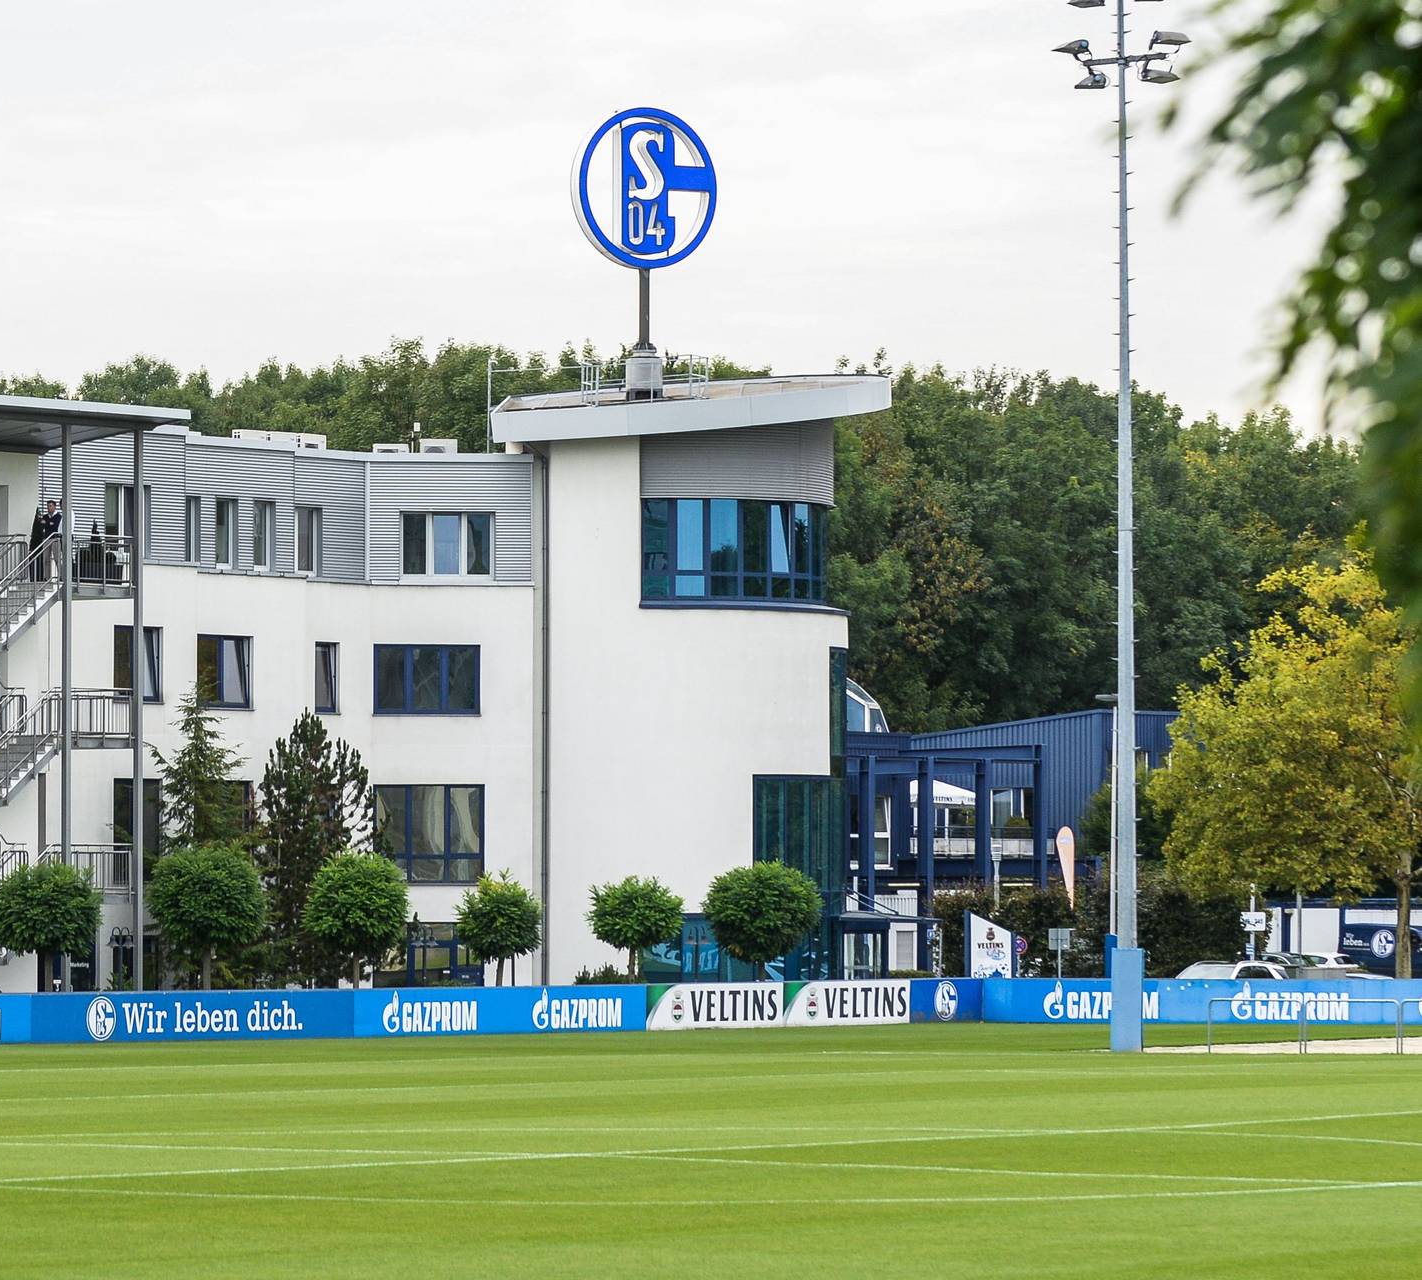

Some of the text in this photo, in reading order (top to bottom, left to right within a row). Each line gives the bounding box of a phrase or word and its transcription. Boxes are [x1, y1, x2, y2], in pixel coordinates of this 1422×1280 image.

[628, 201, 666, 246] 04
[977, 942, 1004, 950] VELTINS
[121, 1000, 303, 1034] Wir leben dich.
[402, 1000, 477, 1033] GAZPROM
[550, 998, 622, 1029] GAZPROM
[690, 989, 778, 1022] VELTINS
[824, 986, 907, 1019] VELTINS
[1066, 991, 1159, 1020] GAZPM
[1254, 991, 1349, 1021] GAZPROM
